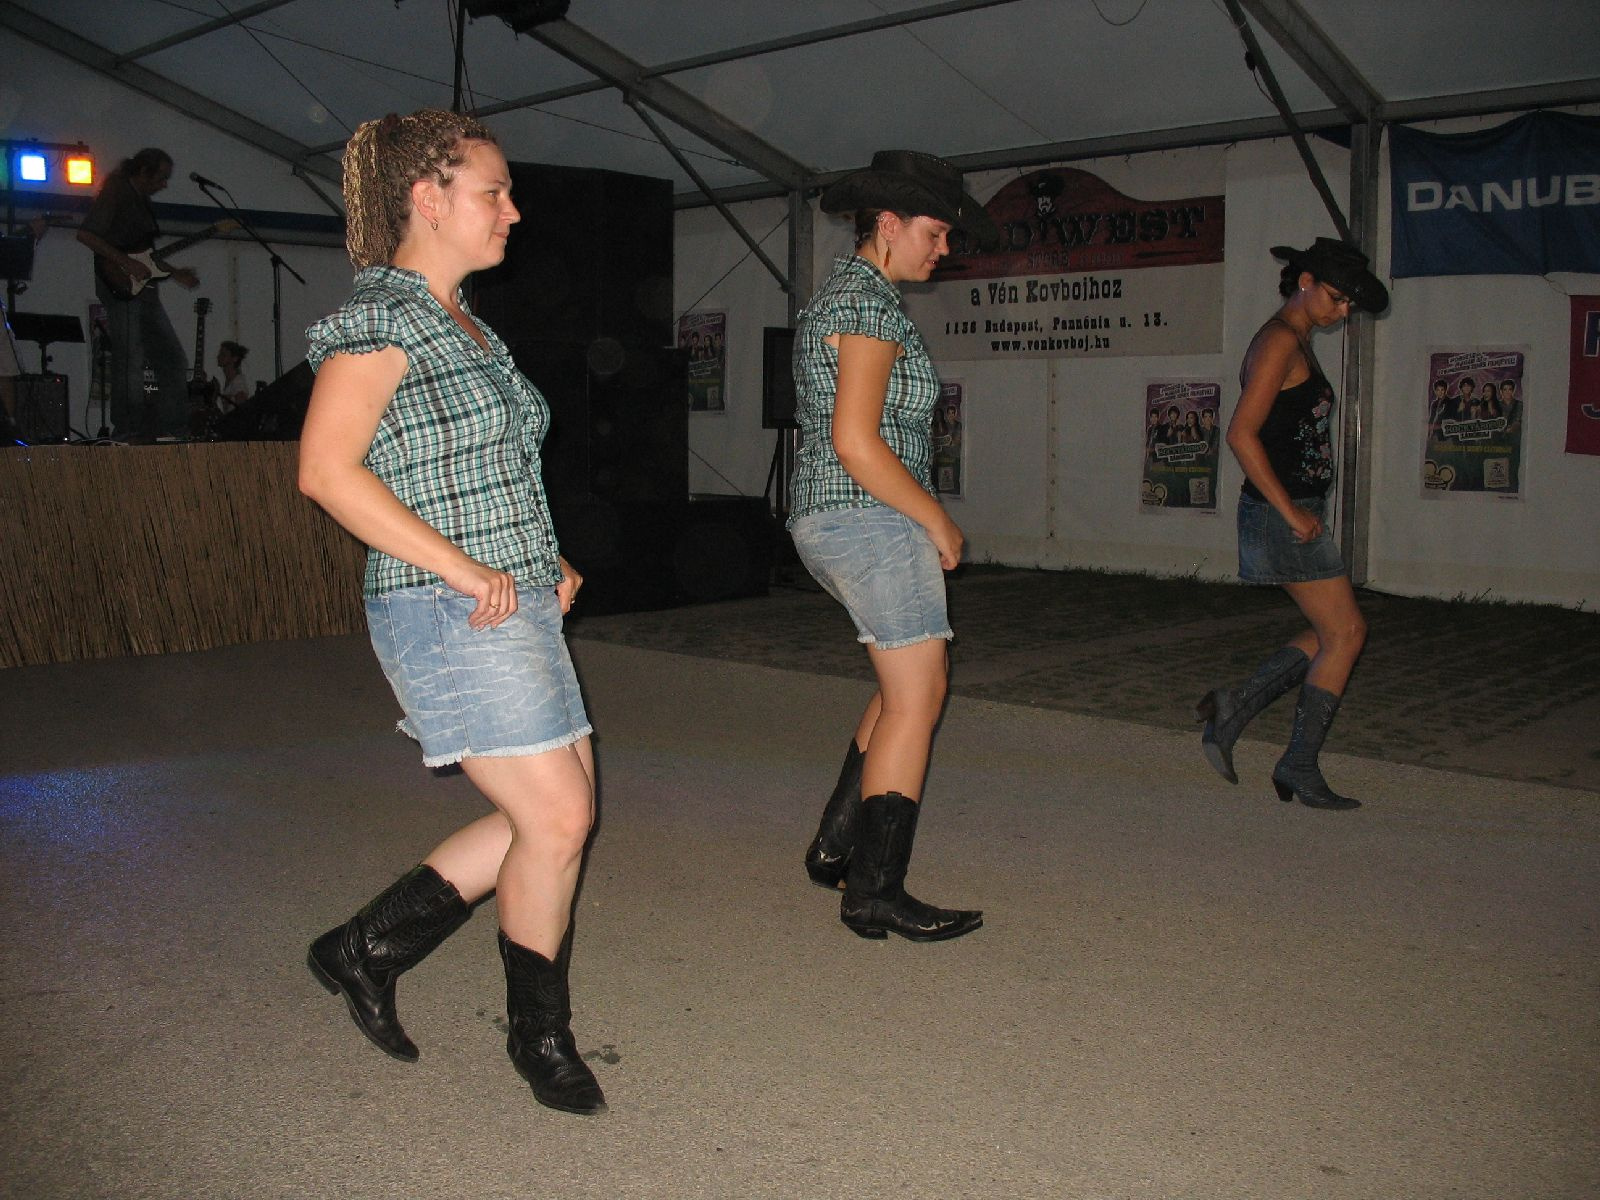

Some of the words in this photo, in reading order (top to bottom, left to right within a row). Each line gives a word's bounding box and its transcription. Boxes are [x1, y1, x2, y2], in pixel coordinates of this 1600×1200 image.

[1407, 174, 1600, 212] DANUB
[970, 288, 980, 306] a
[988, 282, 1018, 305] Vén
[1026, 277, 1122, 304] Kovbojhoz
[985, 318, 1043, 336] Budapest,
